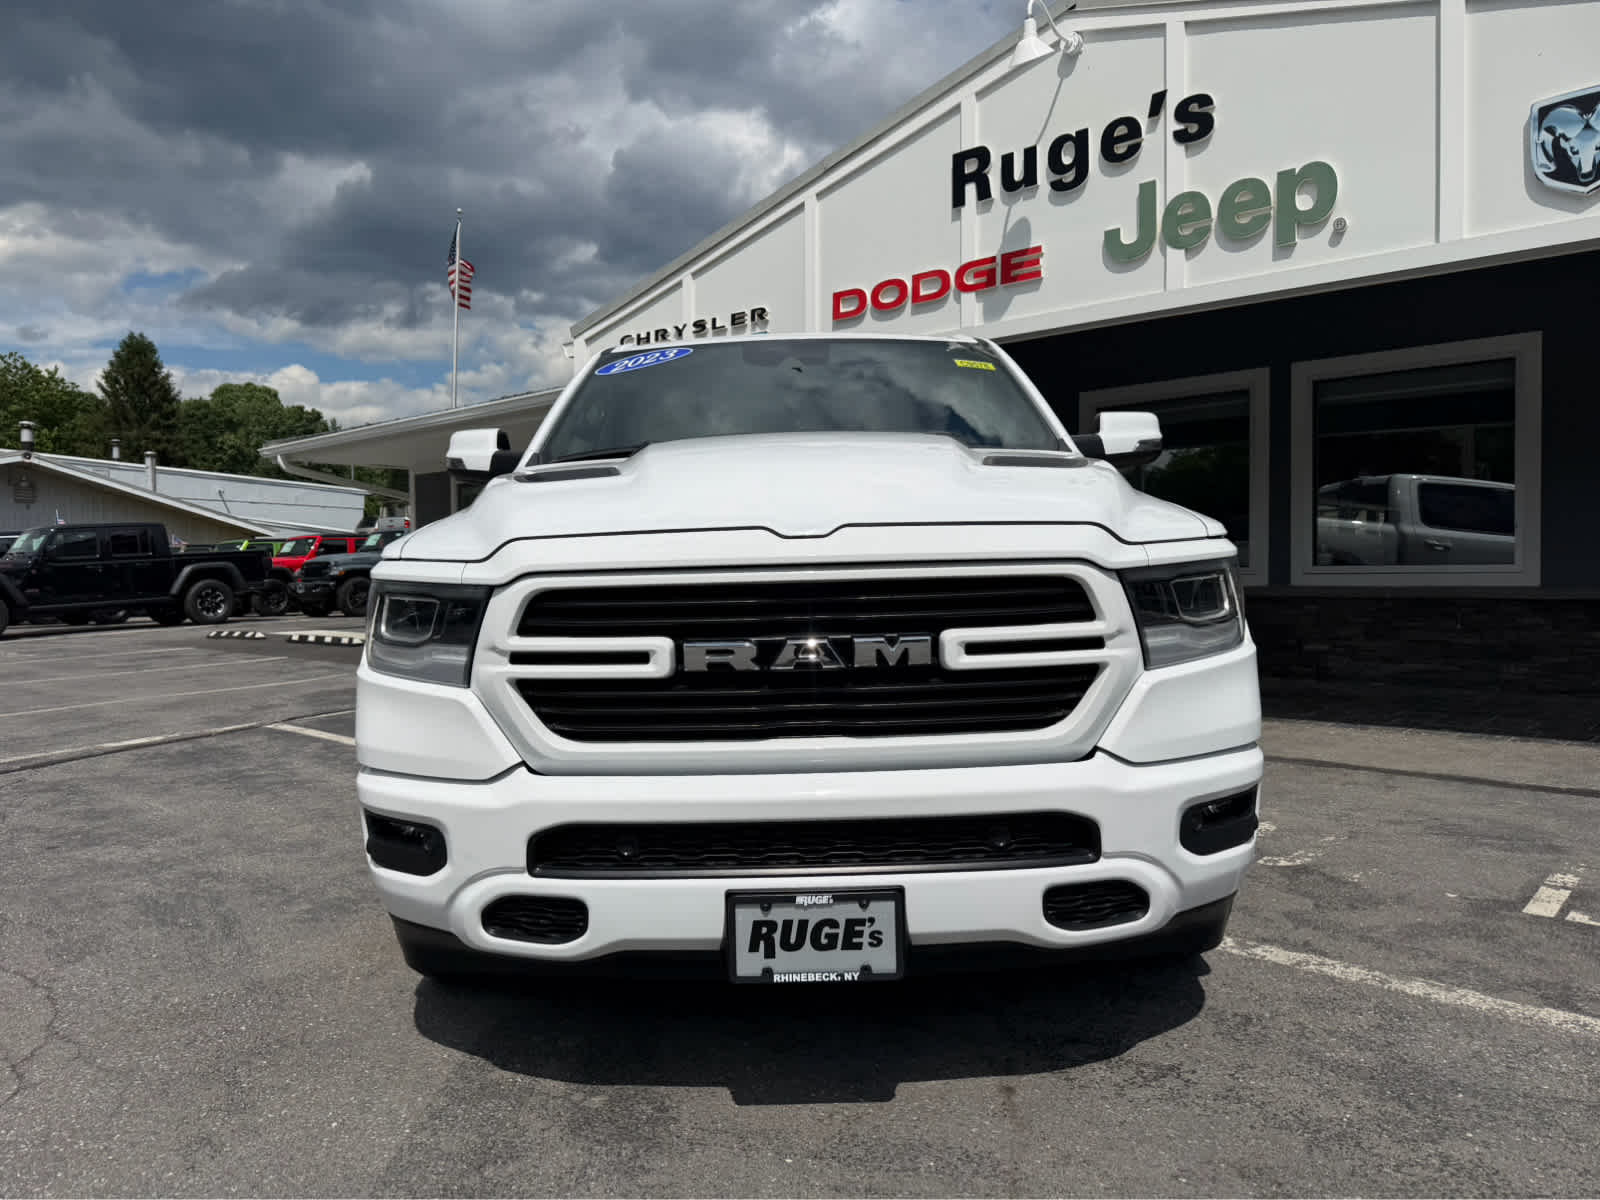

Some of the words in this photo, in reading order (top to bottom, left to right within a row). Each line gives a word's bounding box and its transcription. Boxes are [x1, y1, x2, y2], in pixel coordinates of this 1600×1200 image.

[952, 89, 1216, 209] Ruge's
[1103, 160, 1339, 263] Jeep
[832, 245, 1043, 320] DODGE
[620, 306, 769, 346] CHRYSLER
[609, 349, 678, 374] 2023
[683, 635, 932, 672] RAM
[747, 916, 884, 960] RUGE's
[844, 971, 861, 982] NY
